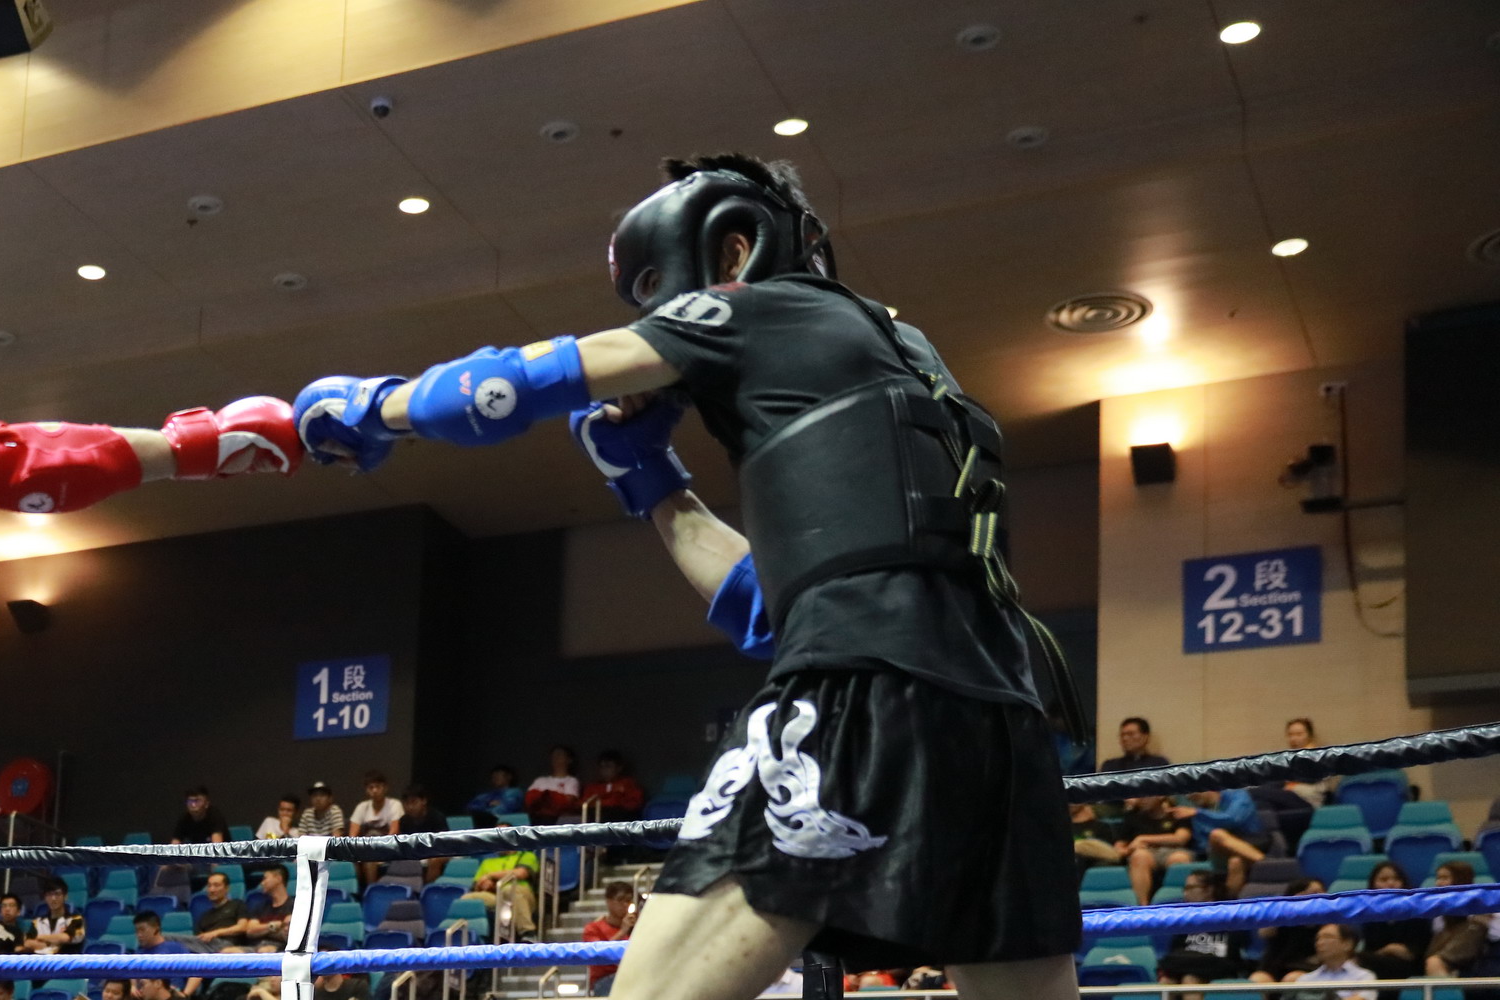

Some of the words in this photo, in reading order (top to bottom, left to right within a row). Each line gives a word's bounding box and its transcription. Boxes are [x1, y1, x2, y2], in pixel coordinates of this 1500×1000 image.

[1202, 564, 1238, 611] 2
[1253, 559, 1289, 591] 段
[1237, 591, 1302, 607] Section
[1197, 605, 1304, 644] 12-31
[312, 667, 329, 704] 1
[342, 665, 366, 691] 段
[332, 691, 374, 703] Section
[312, 704, 371, 732] 1-10
